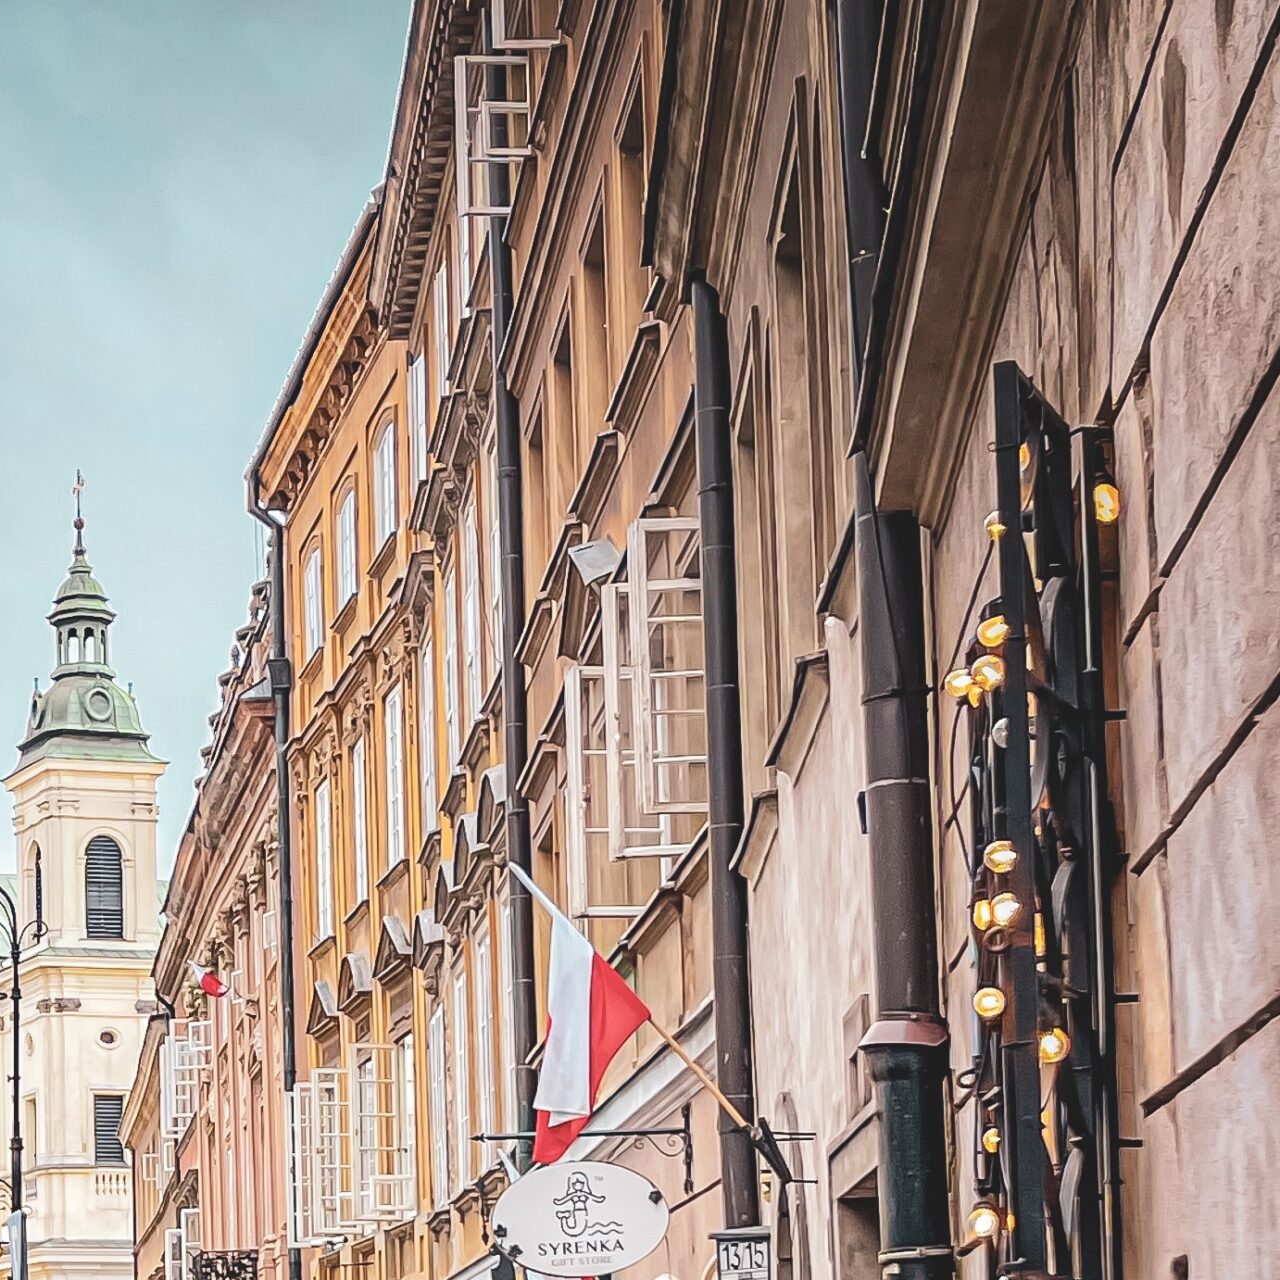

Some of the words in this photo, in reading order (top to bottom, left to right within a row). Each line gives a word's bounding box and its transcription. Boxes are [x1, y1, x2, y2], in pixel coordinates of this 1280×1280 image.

[538, 1239, 625, 1257] SYRENKA
[551, 1257, 575, 1267] GIFT
[577, 1256, 612, 1266] STORE
